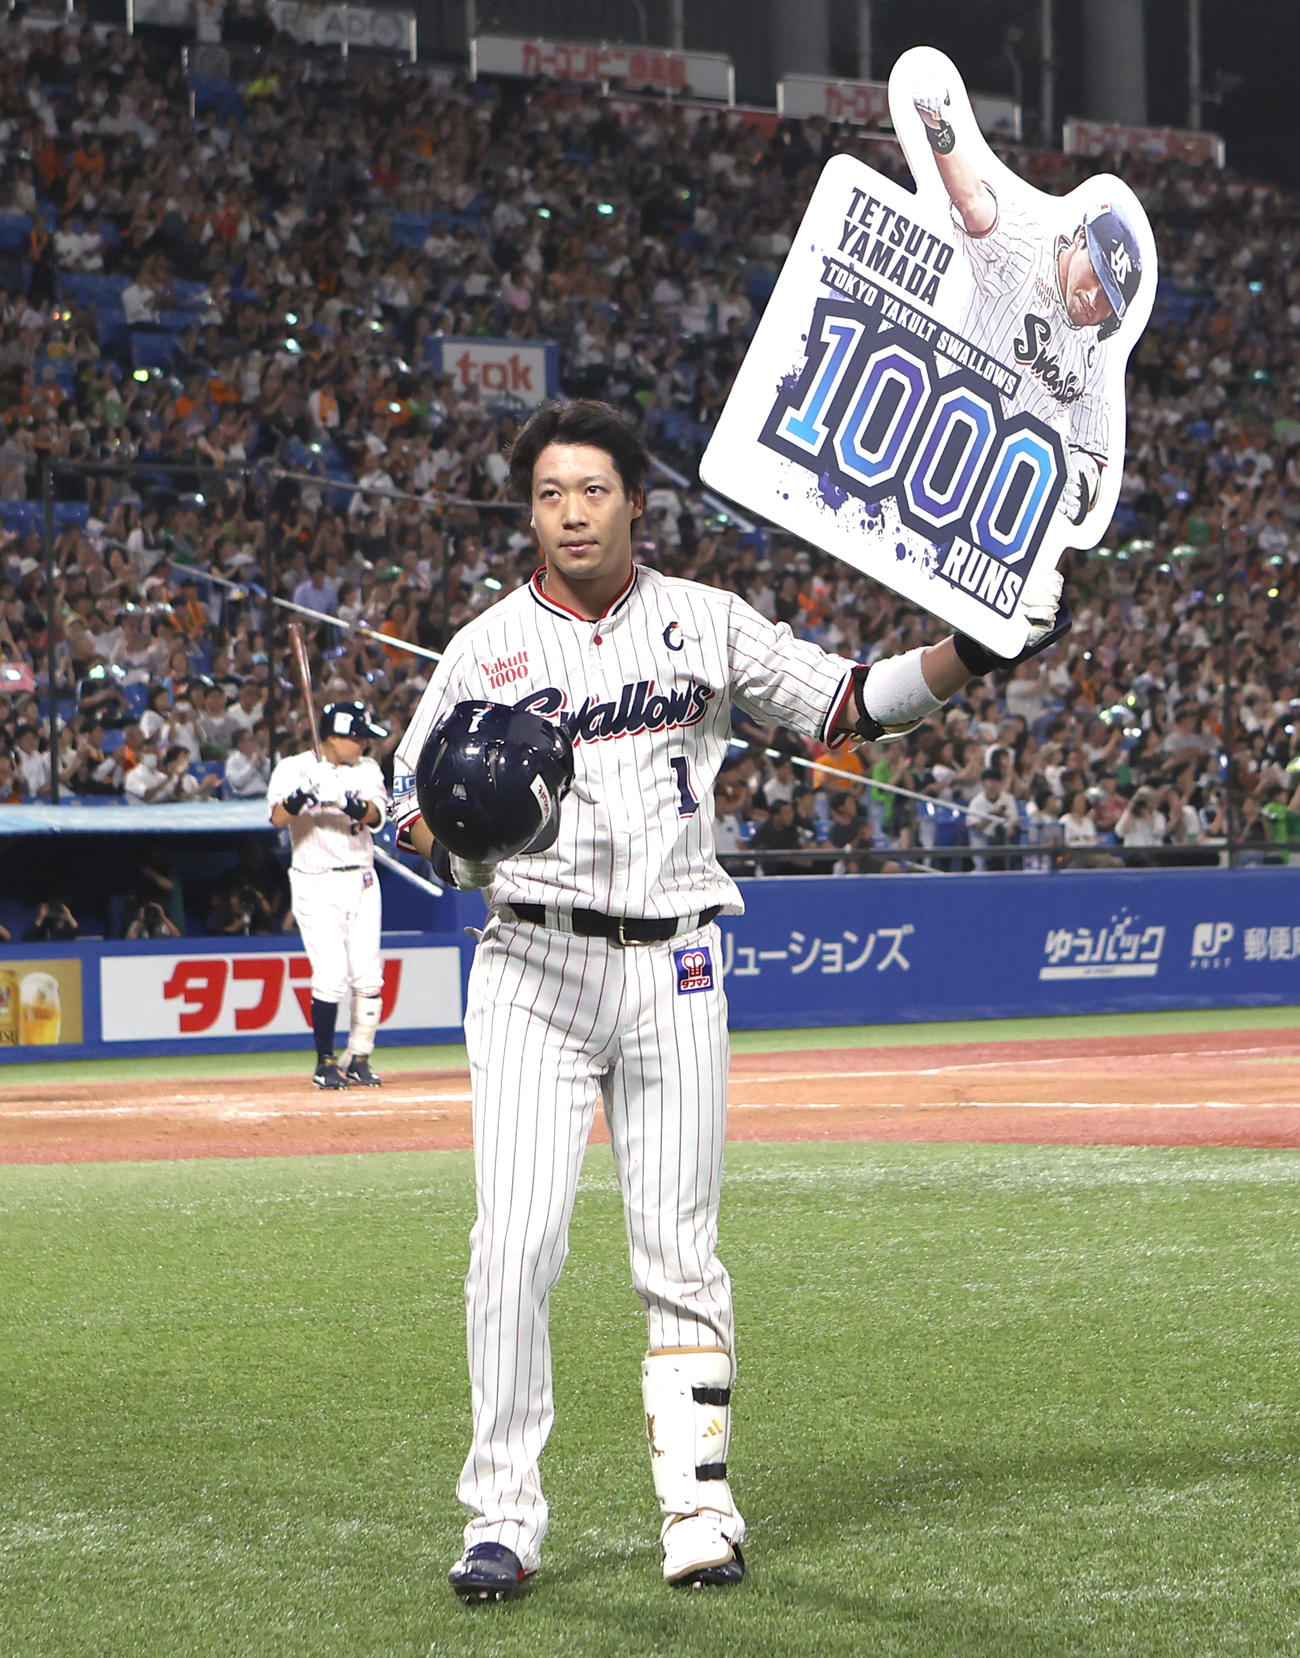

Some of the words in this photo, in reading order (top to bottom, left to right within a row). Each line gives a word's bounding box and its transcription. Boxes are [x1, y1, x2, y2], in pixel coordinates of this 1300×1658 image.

[846, 186, 955, 275] TETSUTO
[837, 219, 941, 307] YAMADA
[826, 262, 879, 307] TOKYO
[880, 294, 938, 342] YAKULT
[936, 330, 1018, 395] SWALLOWS
[775, 315, 1059, 565] 1000
[940, 535, 1023, 618] RUNS
[480, 650, 530, 677] Yakult
[662, 621, 684, 652] C
[487, 664, 529, 690] 1000
[669, 756, 700, 819] 1
[1243, 926, 1300, 961] 郵便
[681, 977, 710, 989] タフマン
